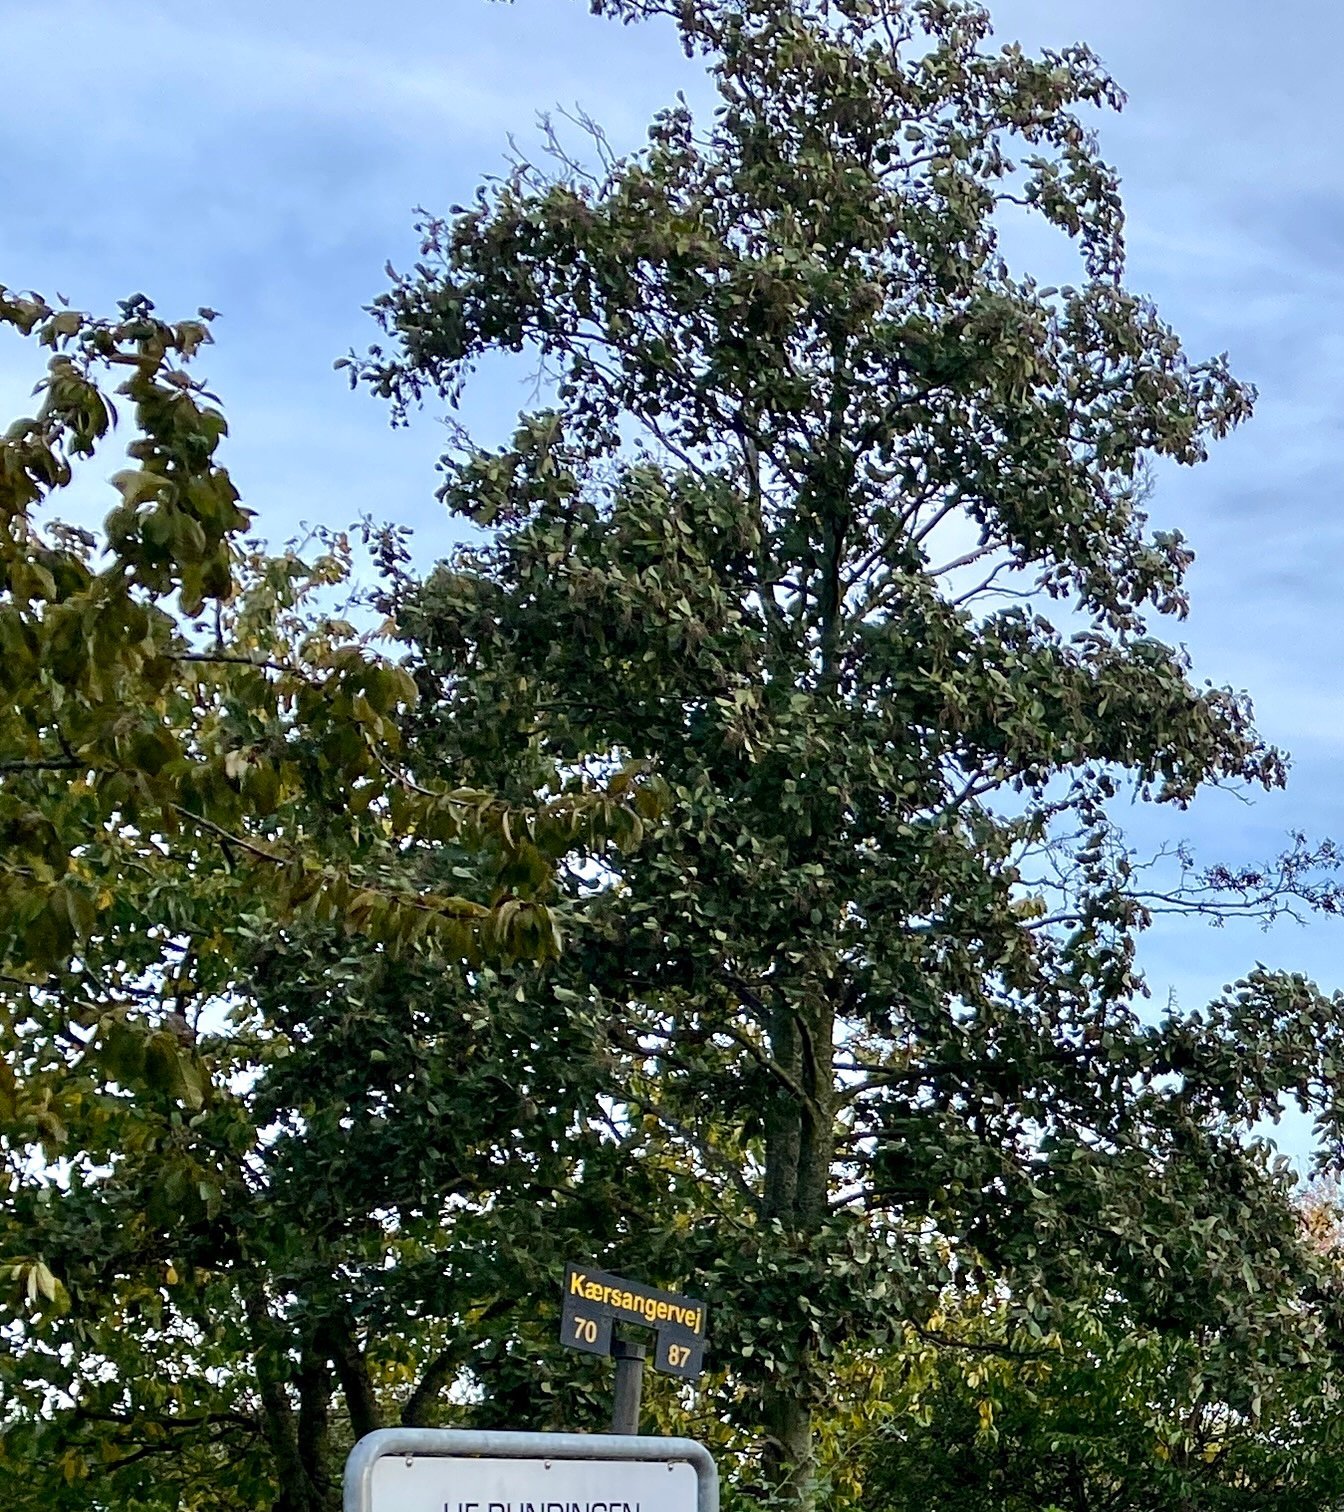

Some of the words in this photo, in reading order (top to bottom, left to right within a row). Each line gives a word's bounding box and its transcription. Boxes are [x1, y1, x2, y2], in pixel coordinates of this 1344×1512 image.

[570, 1271, 701, 1335] Kærsangervej
[574, 1316, 597, 1343] 70
[668, 1343, 691, 1368] 87
